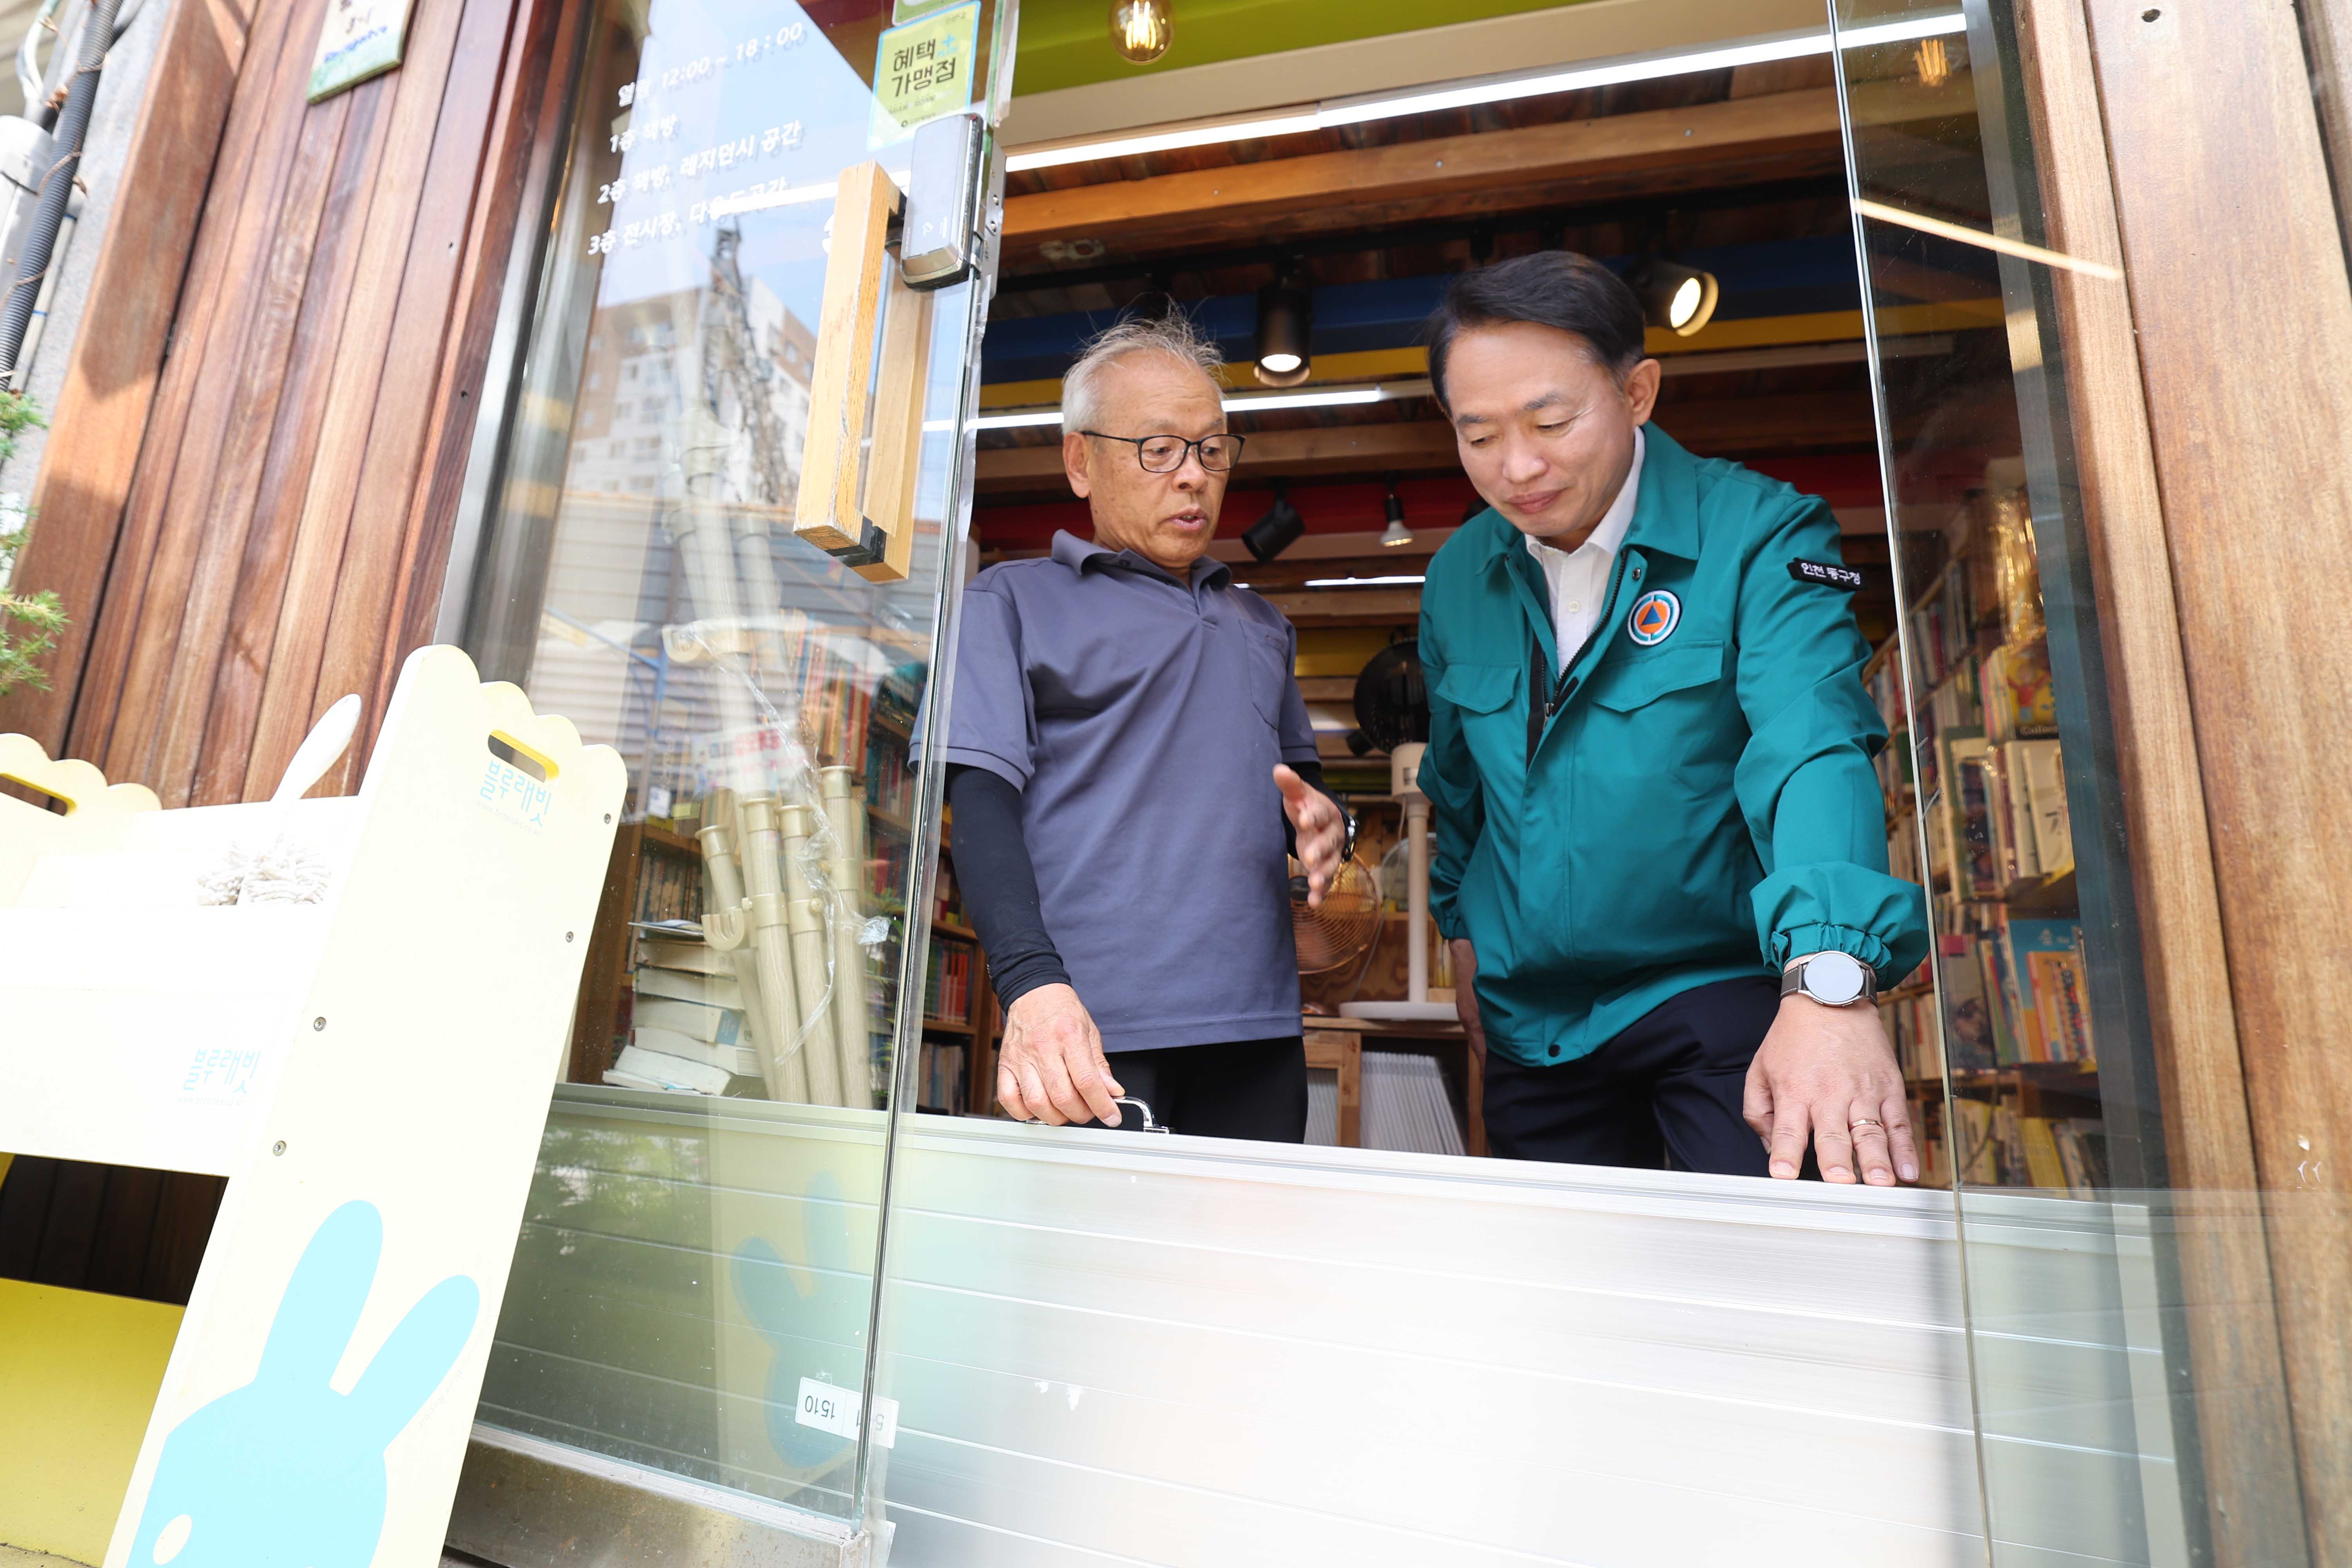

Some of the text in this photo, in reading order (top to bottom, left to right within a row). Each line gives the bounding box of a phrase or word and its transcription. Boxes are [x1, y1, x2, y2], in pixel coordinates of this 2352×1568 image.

[893, 38, 936, 72] 혜택
[662, 56, 711, 88] 12:00
[892, 57, 956, 97] 가맹점
[610, 128, 637, 152] 1층
[597, 178, 627, 203] 2층
[760, 120, 802, 152] 공간
[588, 229, 617, 255] 3층
[1801, 563, 1861, 585] 인천 동구청
[480, 760, 552, 828] 블루래빗
[183, 1048, 261, 1094] 블루래빗
[805, 1395, 835, 1420] 1510
